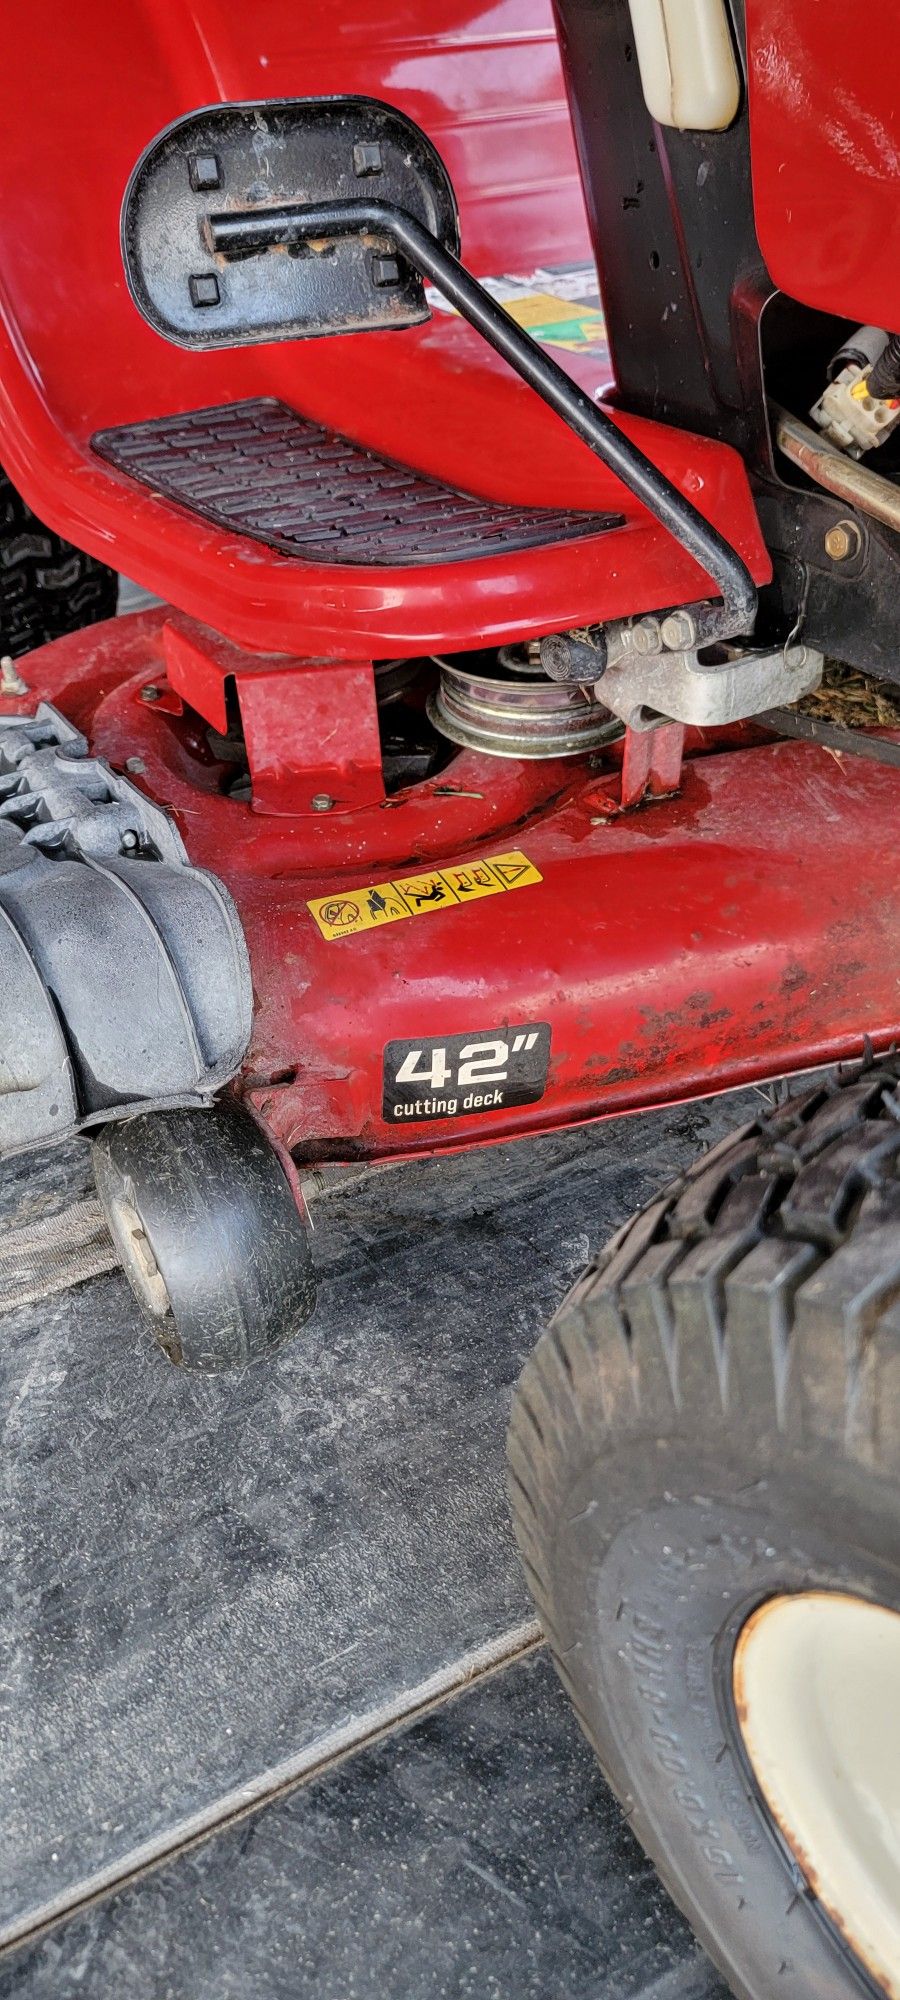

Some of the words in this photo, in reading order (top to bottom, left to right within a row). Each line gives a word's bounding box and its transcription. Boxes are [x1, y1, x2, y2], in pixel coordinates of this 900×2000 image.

[396, 1034, 539, 1088] 42"
[394, 1097, 457, 1117] cutting
[463, 1091, 503, 1109] deck
